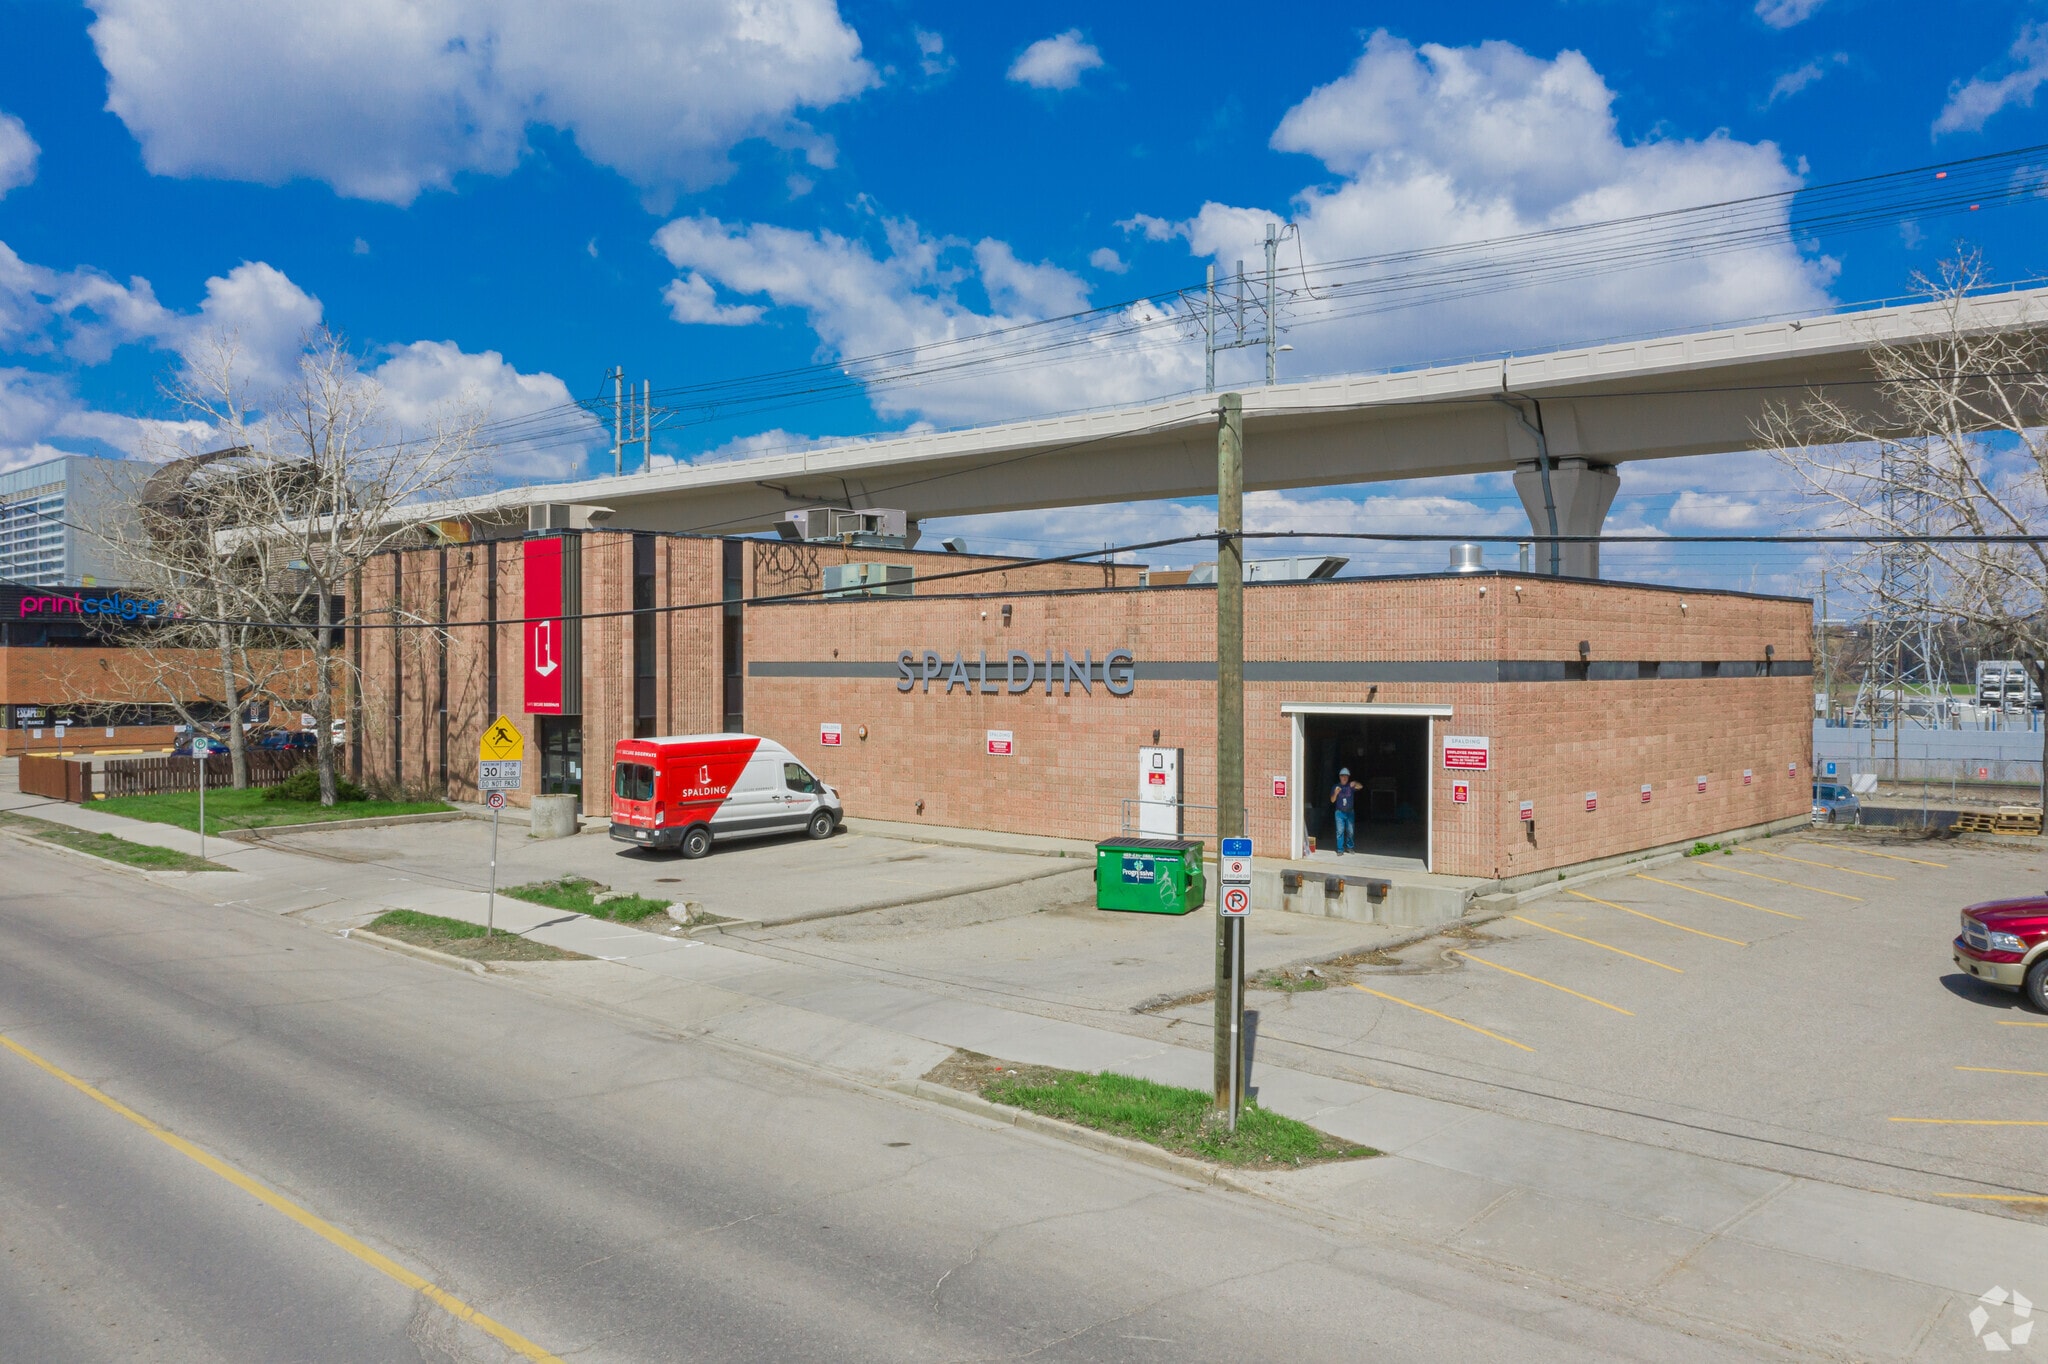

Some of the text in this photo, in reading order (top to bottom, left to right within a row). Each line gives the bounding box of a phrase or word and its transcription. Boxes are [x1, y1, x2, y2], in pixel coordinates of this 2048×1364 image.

[20, 592, 173, 620] printcalgar
[897, 648, 1134, 696] SPALDING
[483, 768, 498, 777] 30
[682, 786, 727, 797] SPALDING
